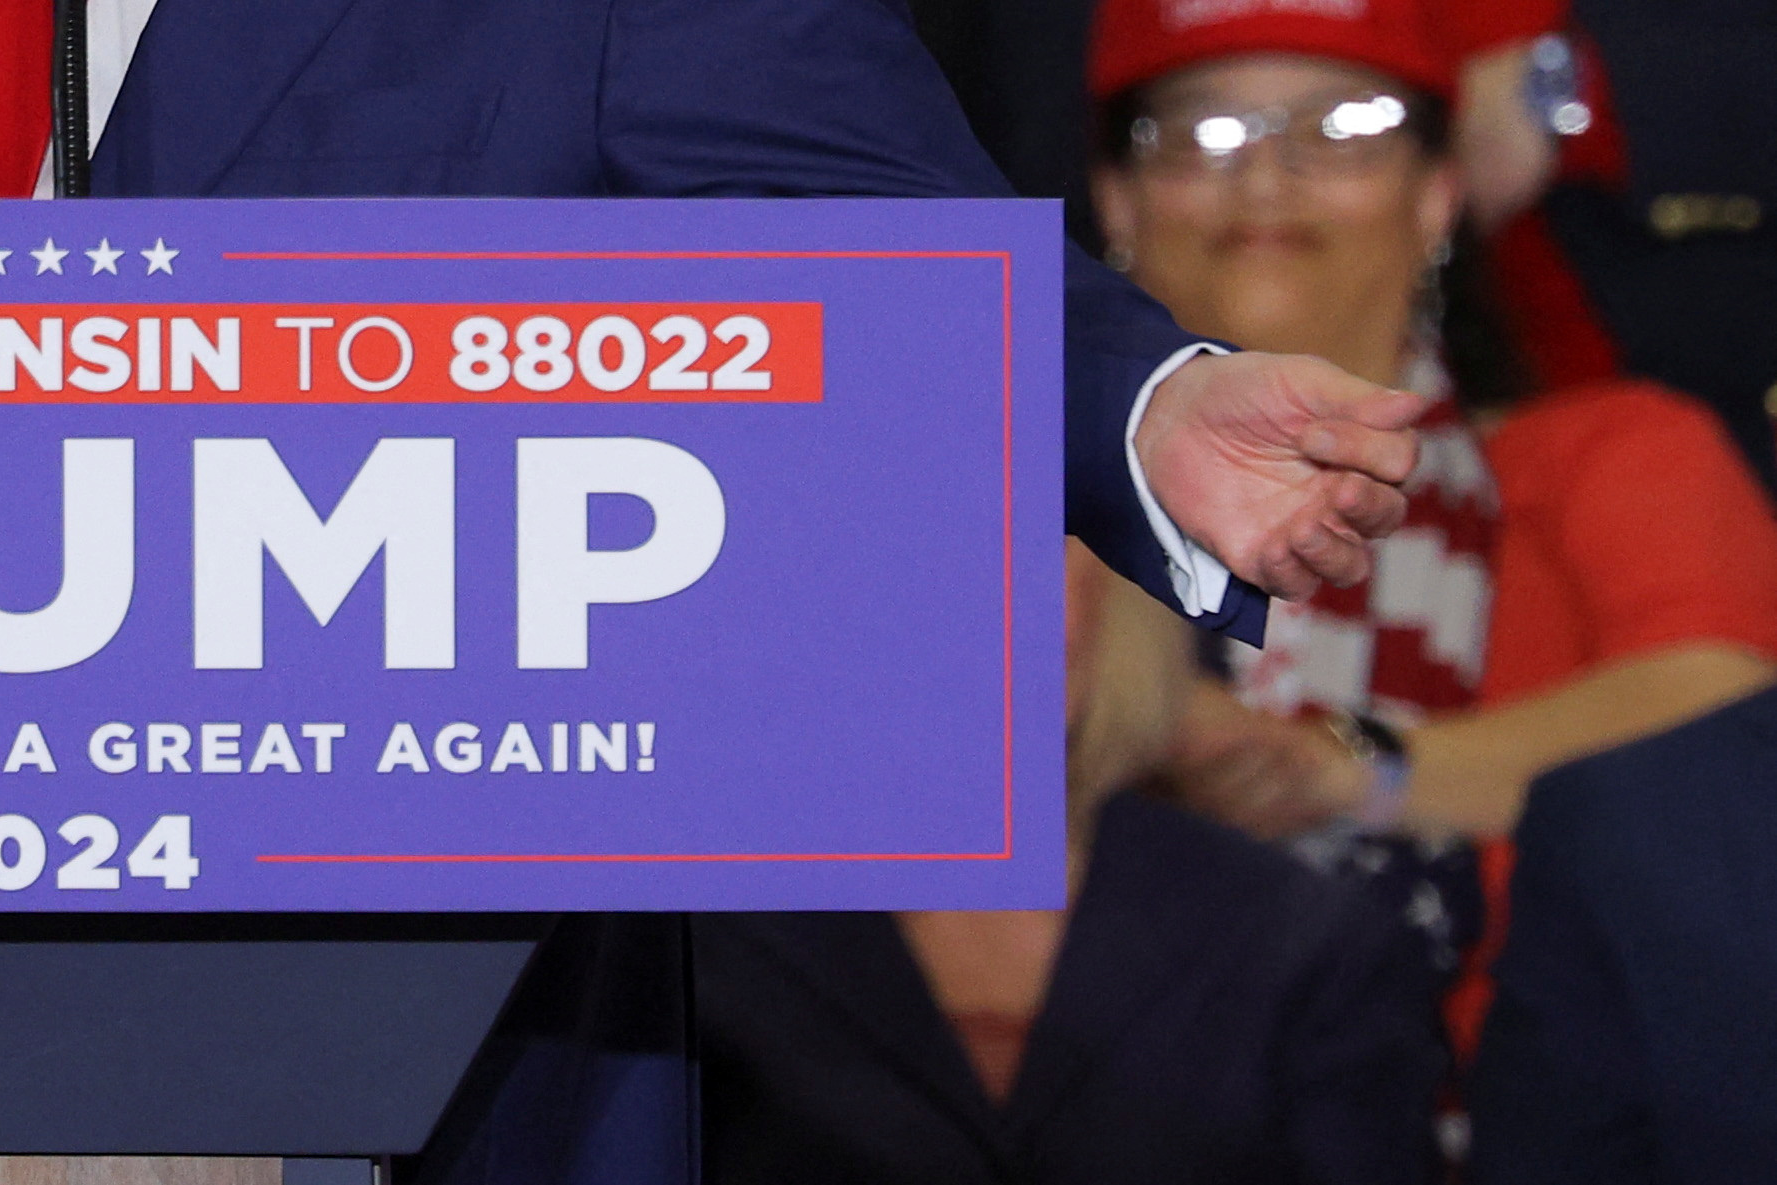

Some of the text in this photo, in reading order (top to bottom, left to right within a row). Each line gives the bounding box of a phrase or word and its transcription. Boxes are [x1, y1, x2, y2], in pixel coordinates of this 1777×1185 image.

[276, 317, 413, 392] TO
[450, 316, 771, 392] 88022
[89, 723, 346, 774] GREAT
[376, 722, 655, 773] AGAIN!
